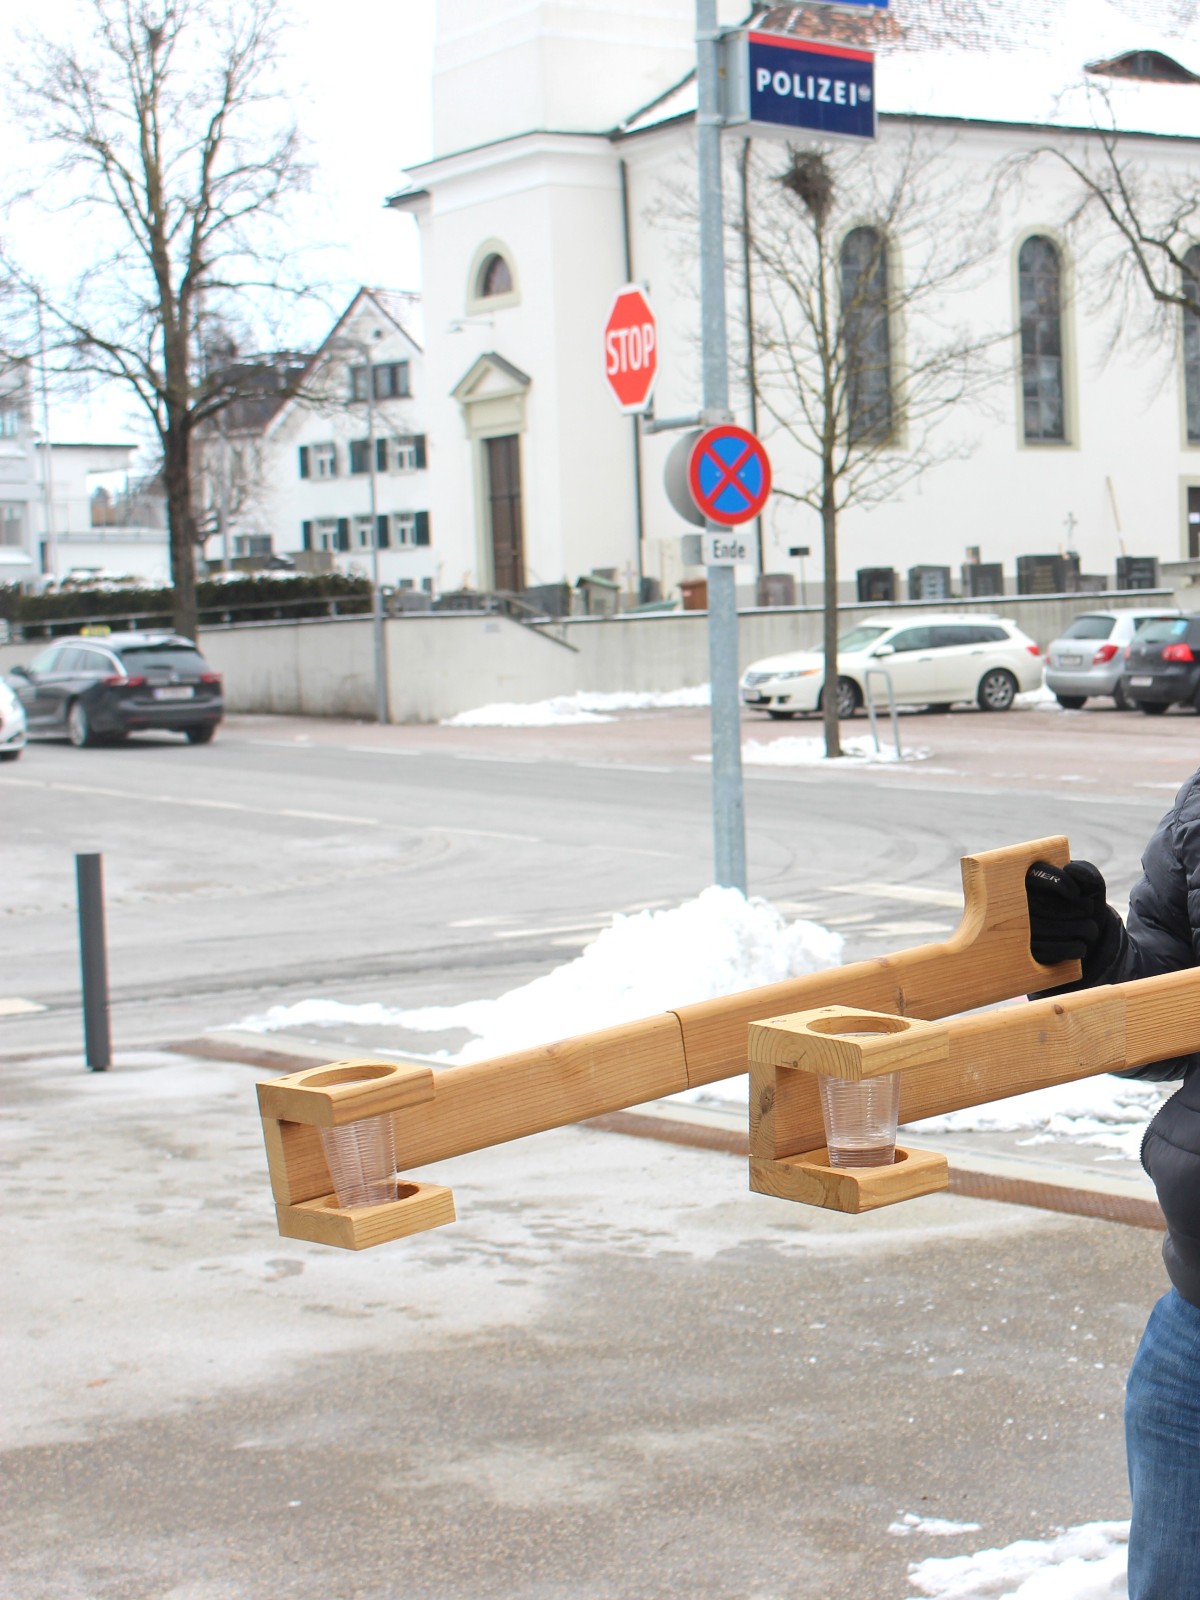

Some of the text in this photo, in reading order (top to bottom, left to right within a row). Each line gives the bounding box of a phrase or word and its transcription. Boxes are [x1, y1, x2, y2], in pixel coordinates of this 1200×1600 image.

[756, 66, 858, 108] POLIZEI
[606, 321, 656, 376] STOP
[713, 539, 746, 559] Ende
